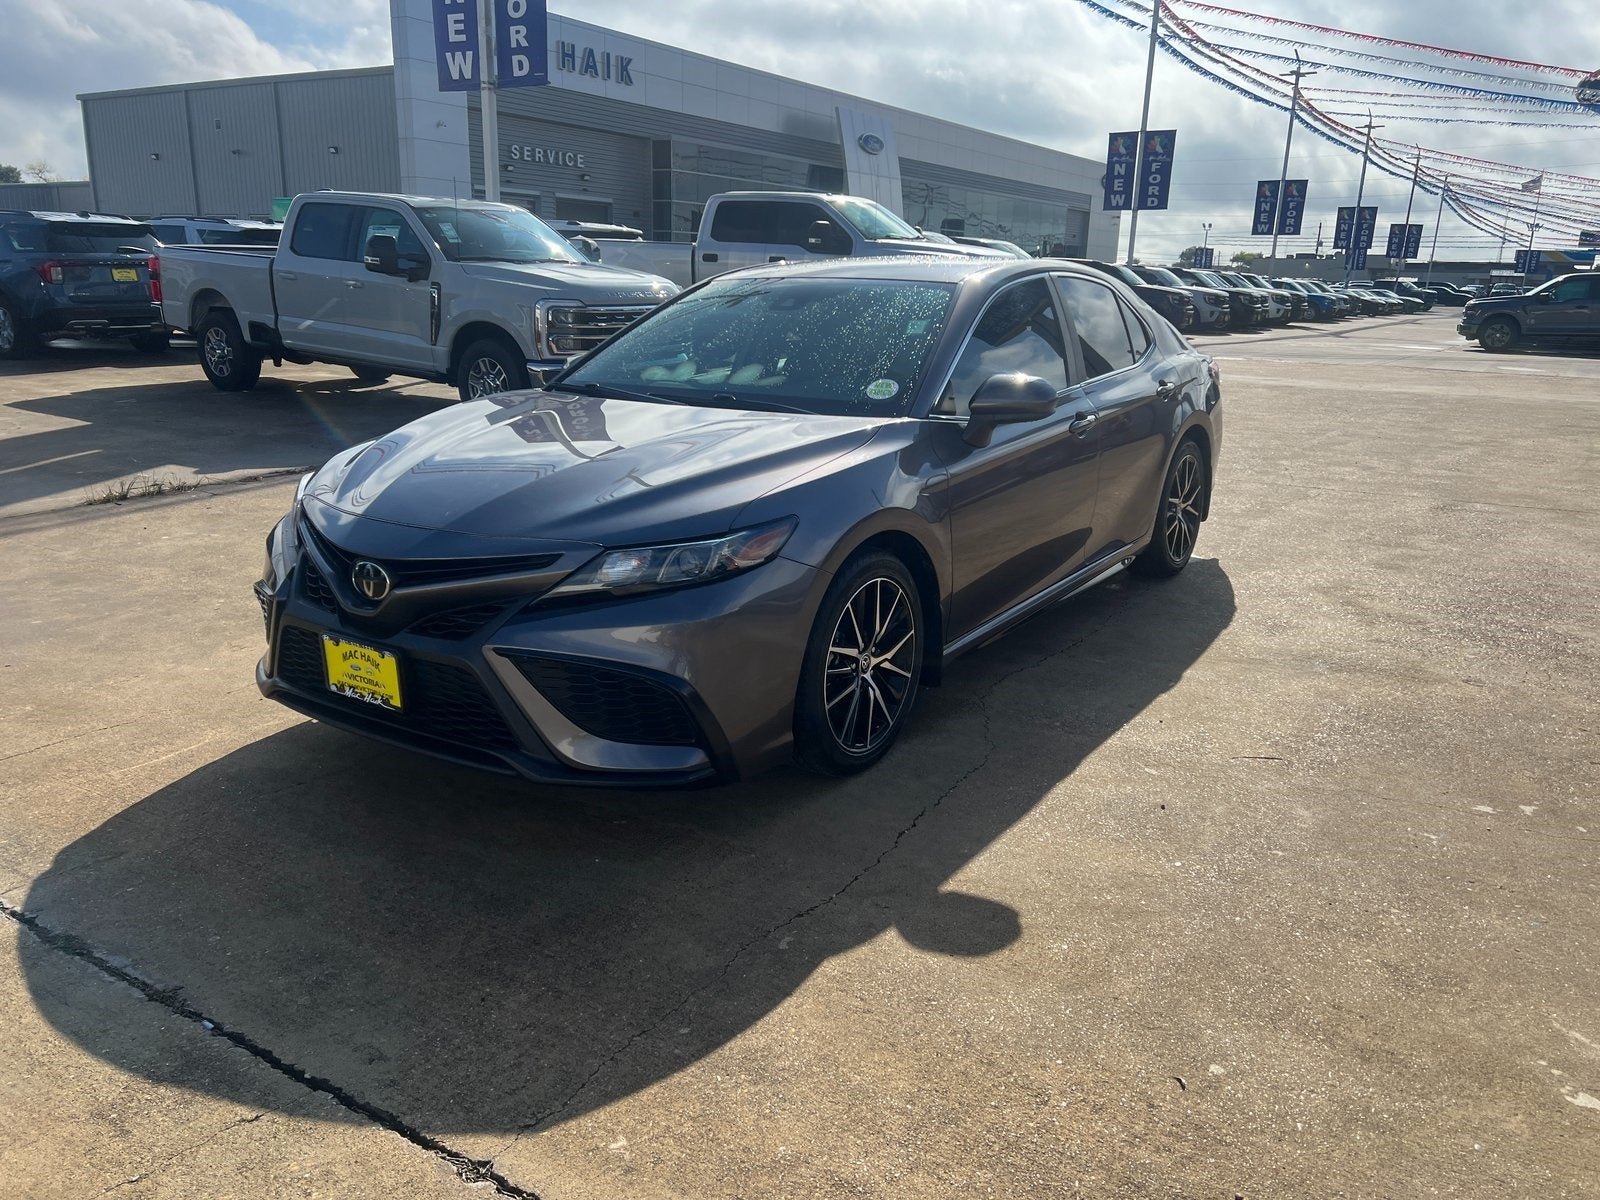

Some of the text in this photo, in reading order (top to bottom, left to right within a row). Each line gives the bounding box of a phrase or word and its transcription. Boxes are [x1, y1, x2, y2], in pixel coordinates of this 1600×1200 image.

[445, 0, 473, 80] EW
[557, 41, 634, 86] HAIK
[511, 144, 585, 168] SERVICE
[1110, 163, 1126, 207] NEW
[1146, 162, 1162, 208] FORD
[1257, 202, 1271, 233] NEW
[1285, 202, 1297, 234] FORD
[1337, 223, 1349, 247] NEW
[1359, 223, 1369, 248] FORD
[1389, 237, 1399, 257] NEW
[1407, 238, 1416, 257] FORD
[342, 650, 359, 662] MAC
[360, 651, 381, 672] HAIK
[347, 673, 380, 688] VICTORIA
[344, 688, 383, 705] Mac Haik
